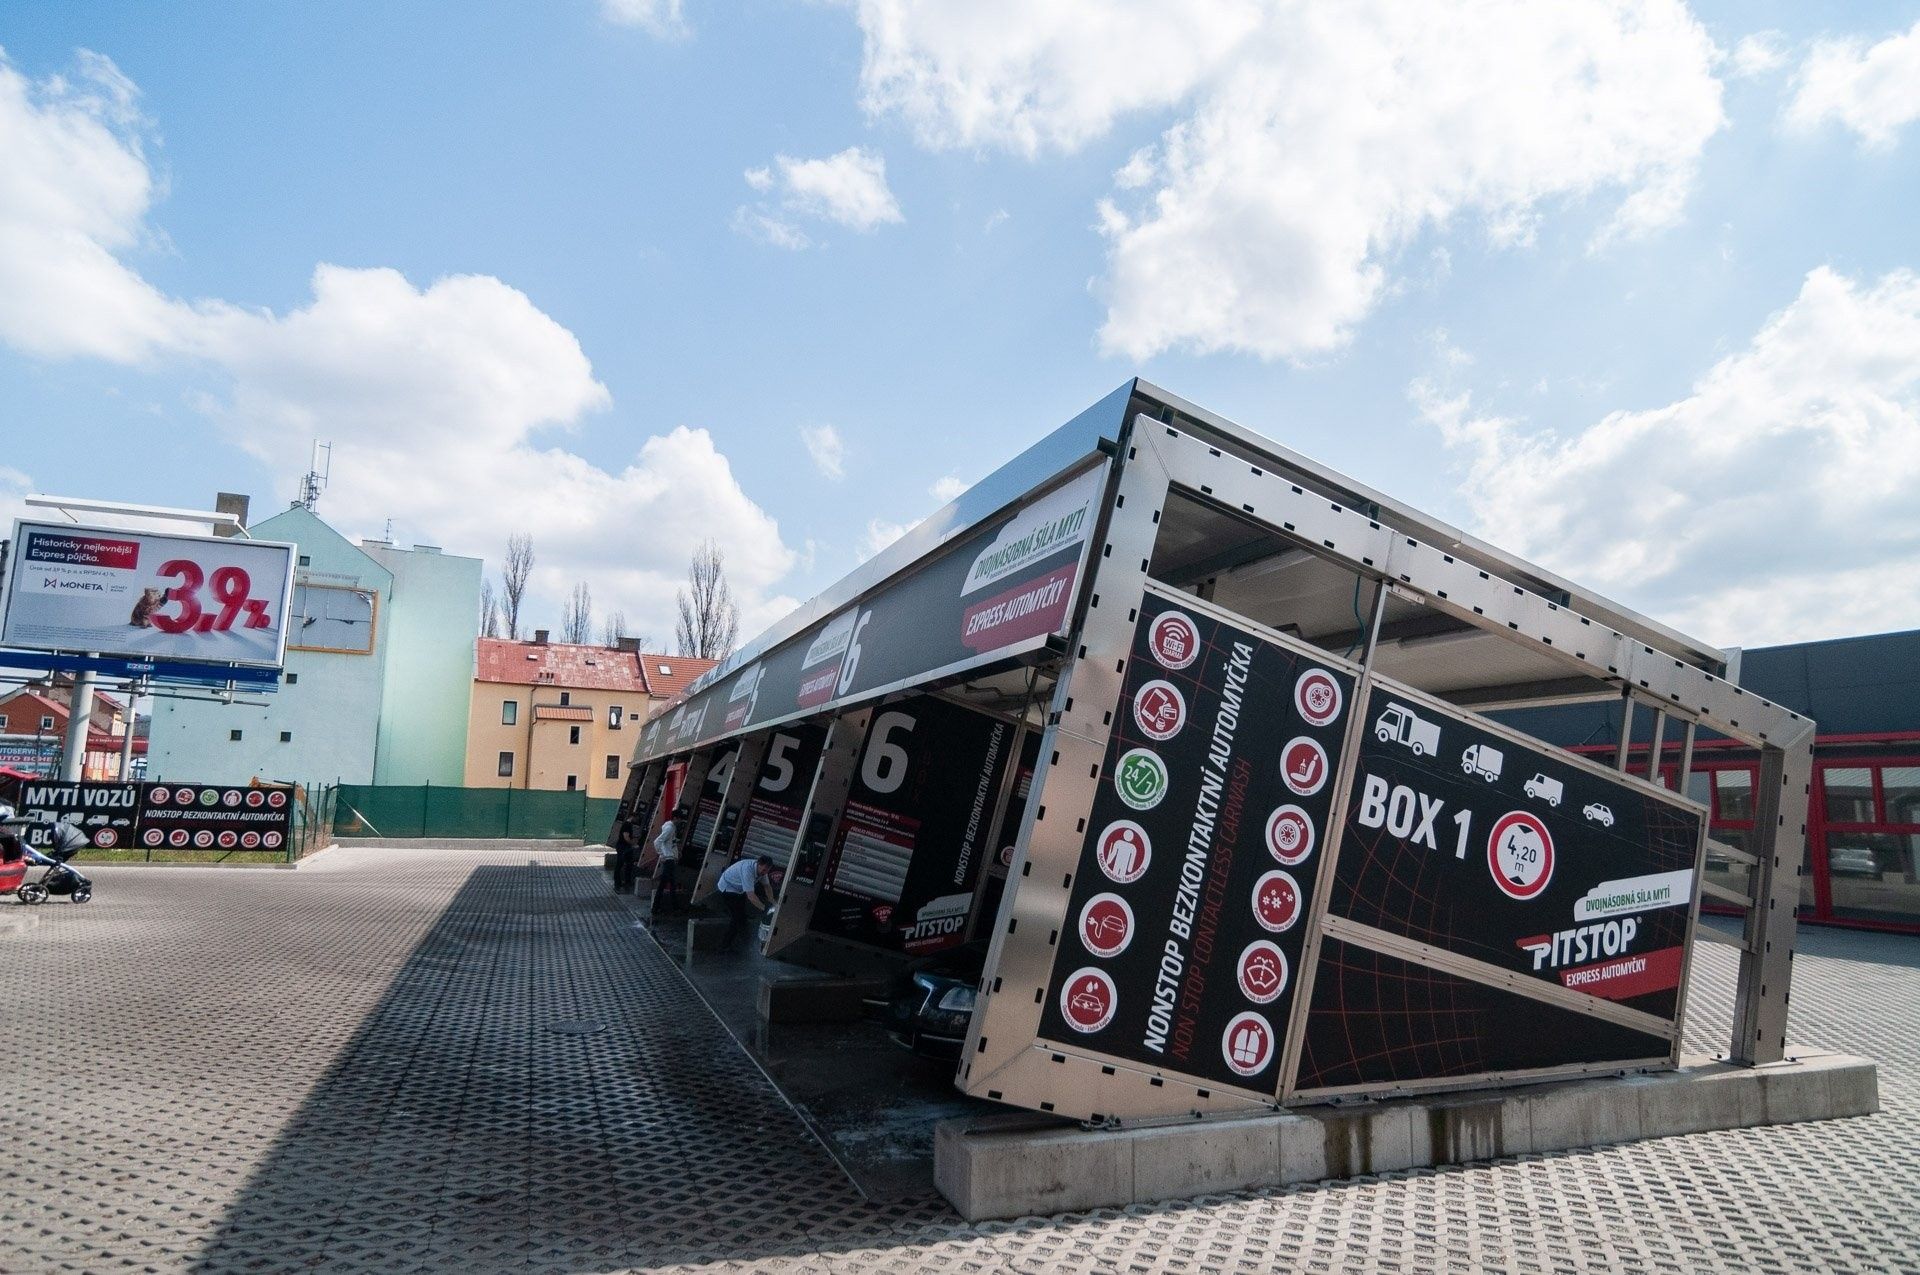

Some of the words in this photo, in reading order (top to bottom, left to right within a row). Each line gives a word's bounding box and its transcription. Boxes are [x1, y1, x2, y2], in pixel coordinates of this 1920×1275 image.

[31, 548, 65, 559] Expres
[33, 537, 82, 551] Historicky
[974, 528, 1036, 579] DVOJNÁSOBNÁ
[1033, 522, 1057, 551] SÍLA
[1055, 499, 1089, 540] MYTÍ
[60, 581, 103, 591] MONETA
[966, 603, 1006, 637] EXPRESS
[1002, 577, 1067, 623] AUTOMYČKY
[839, 610, 872, 696] 6
[759, 732, 801, 792] 5
[861, 711, 918, 793] 6
[707, 750, 738, 794] 4
[1125, 765, 1153, 794] 24/7
[25, 784, 80, 806] MYTÍ
[84, 785, 136, 807] VOZŮ
[954, 841, 972, 885] NONSTOP
[966, 773, 990, 843] BEZKONTAKTNÍ
[983, 722, 1004, 778] AUTOMYČKA
[145, 809, 182, 819] NONSTOP
[183, 811, 240, 820] BEZKONTAKTNÍ
[240, 812, 285, 821] AUTOMYČKA
[1358, 773, 1445, 850] BOX
[1453, 808, 1472, 859] 1
[31, 828, 53, 845] BO
[1144, 939, 1184, 1053] NONSTOP
[1169, 766, 1224, 940] BEZKONTAKTNÍ
[1208, 641, 1253, 772] AUTOMYČKA
[1507, 835, 1537, 863] 4,20
[1514, 862, 1525, 872] m
[1586, 890, 1636, 912] DVOJNÁSOBNÁ
[1637, 888, 1652, 902] SÍLA
[1653, 884, 1670, 899] MYTÍ
[902, 916, 964, 940] PITSTOP
[1522, 917, 1637, 970] PITSTOP
[1566, 968, 1601, 986] EXPRESS
[1601, 957, 1646, 980] AUTOMYČKY
